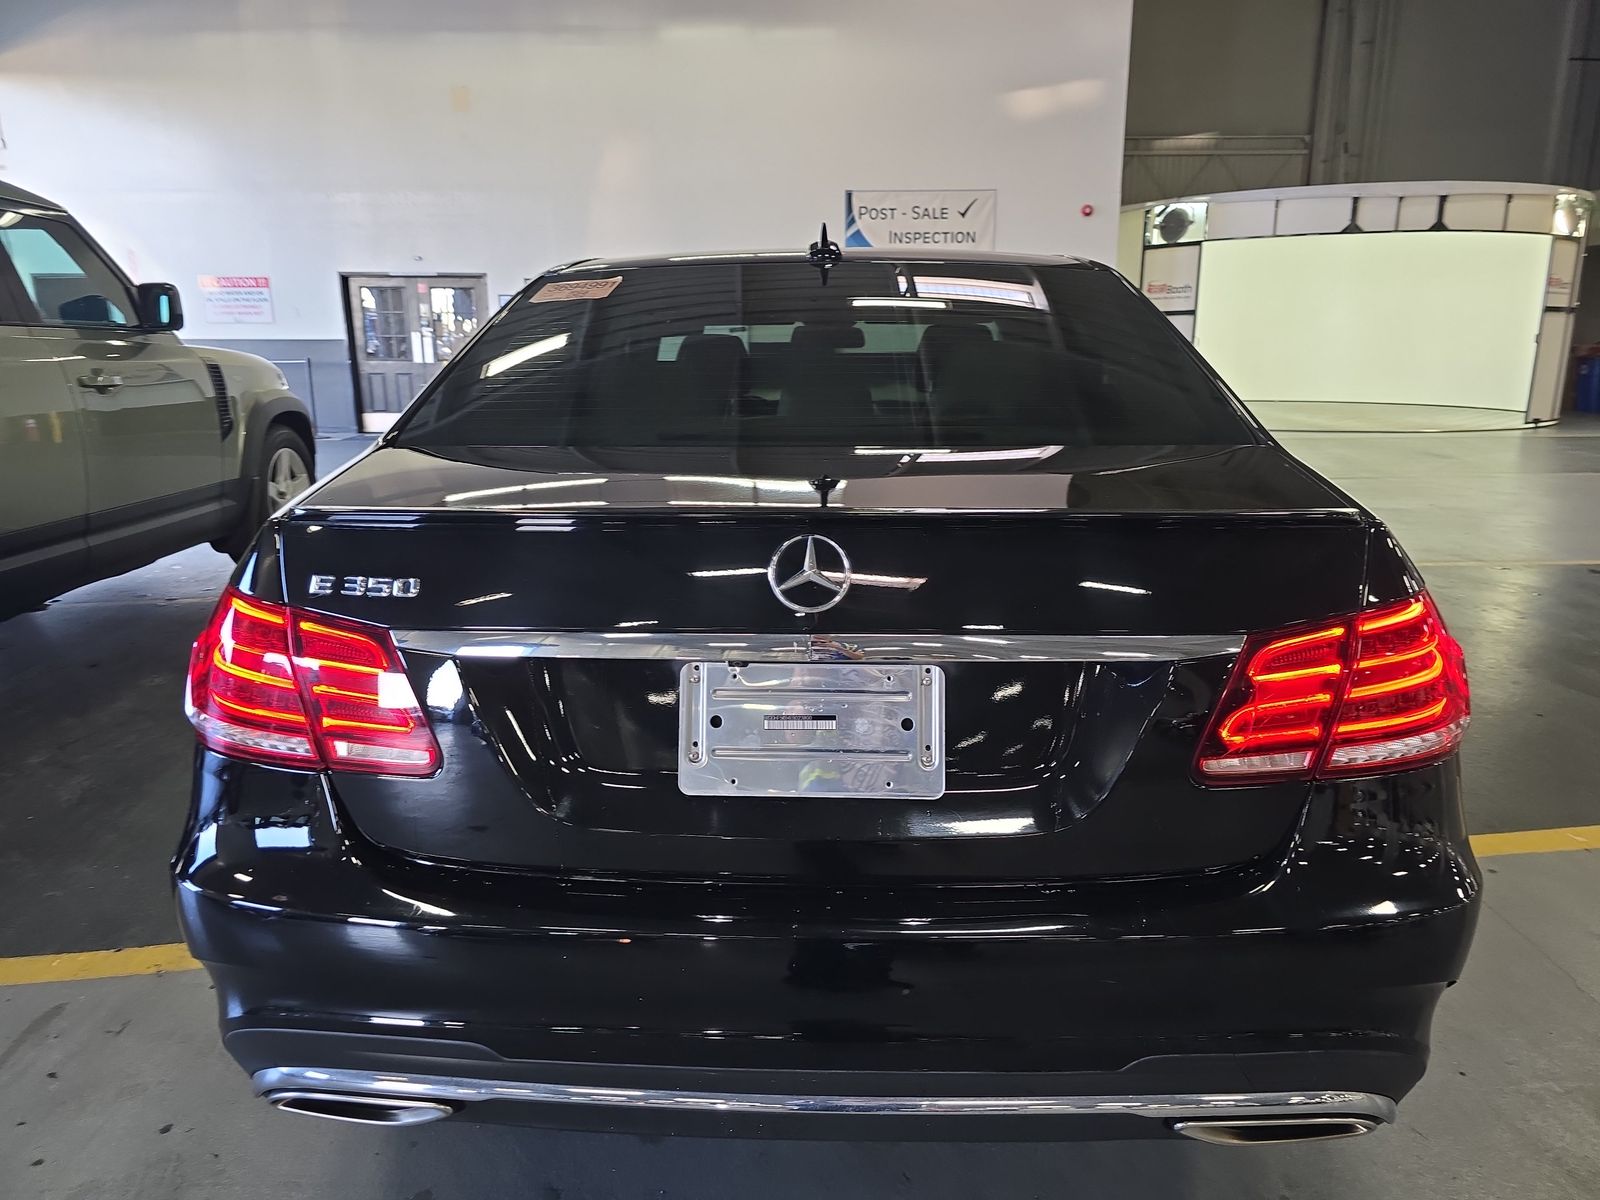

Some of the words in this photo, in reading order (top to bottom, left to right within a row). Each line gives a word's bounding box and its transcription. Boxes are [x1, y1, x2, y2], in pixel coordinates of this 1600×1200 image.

[858, 206, 897, 220] POST
[911, 205, 949, 220] SALE
[888, 230, 977, 244] INSPECTION
[308, 574, 337, 595] E
[340, 576, 421, 598] 350
